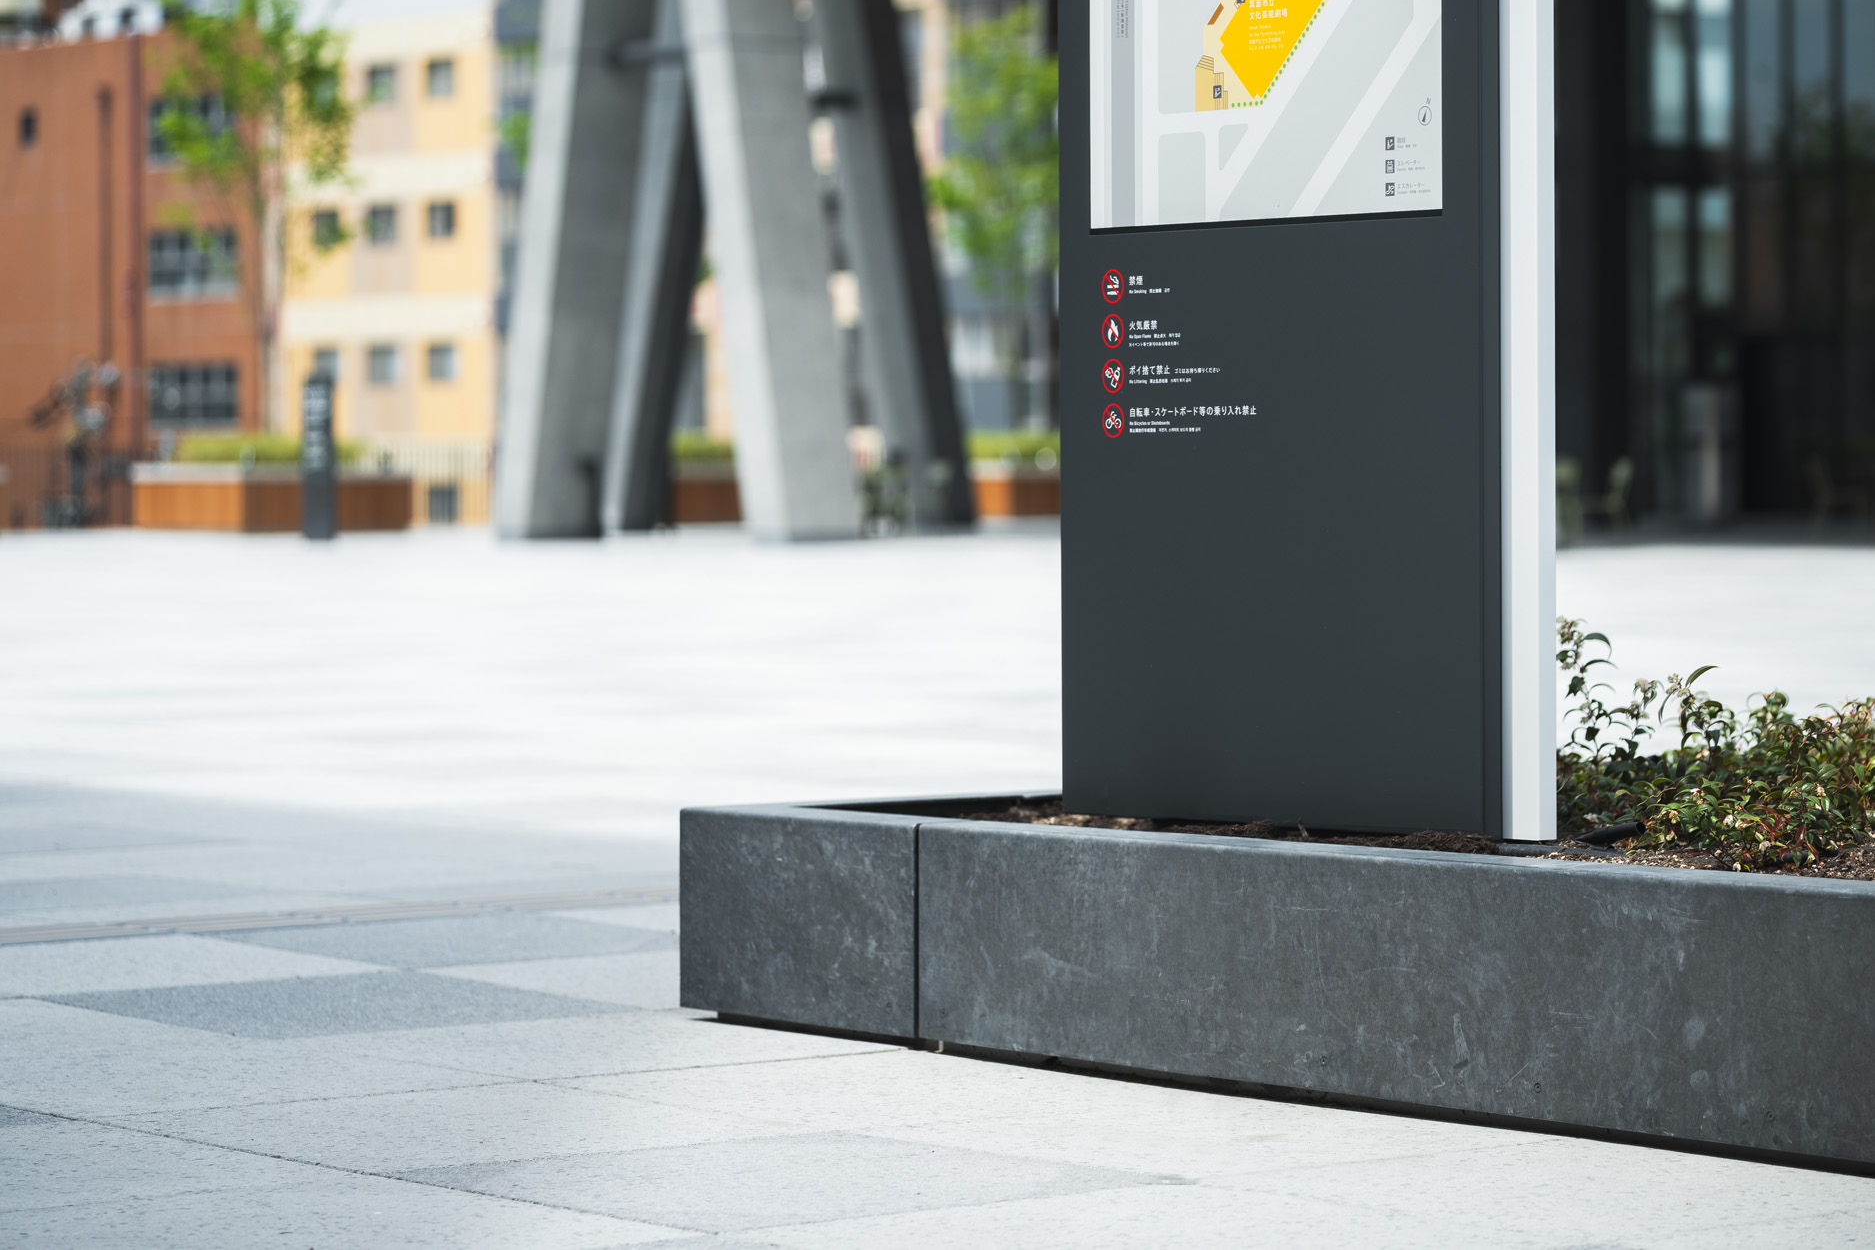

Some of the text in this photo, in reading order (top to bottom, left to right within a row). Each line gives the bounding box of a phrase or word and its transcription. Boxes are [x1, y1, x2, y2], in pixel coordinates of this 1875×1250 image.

[1249, 8, 1288, 20] 文化芸能劇場
[1426, 97, 1432, 105] N
[1129, 275, 1143, 286] 禁煙
[1129, 320, 1158, 330] 火気厳禁
[1129, 365, 1170, 375] ポイ捨て禁止
